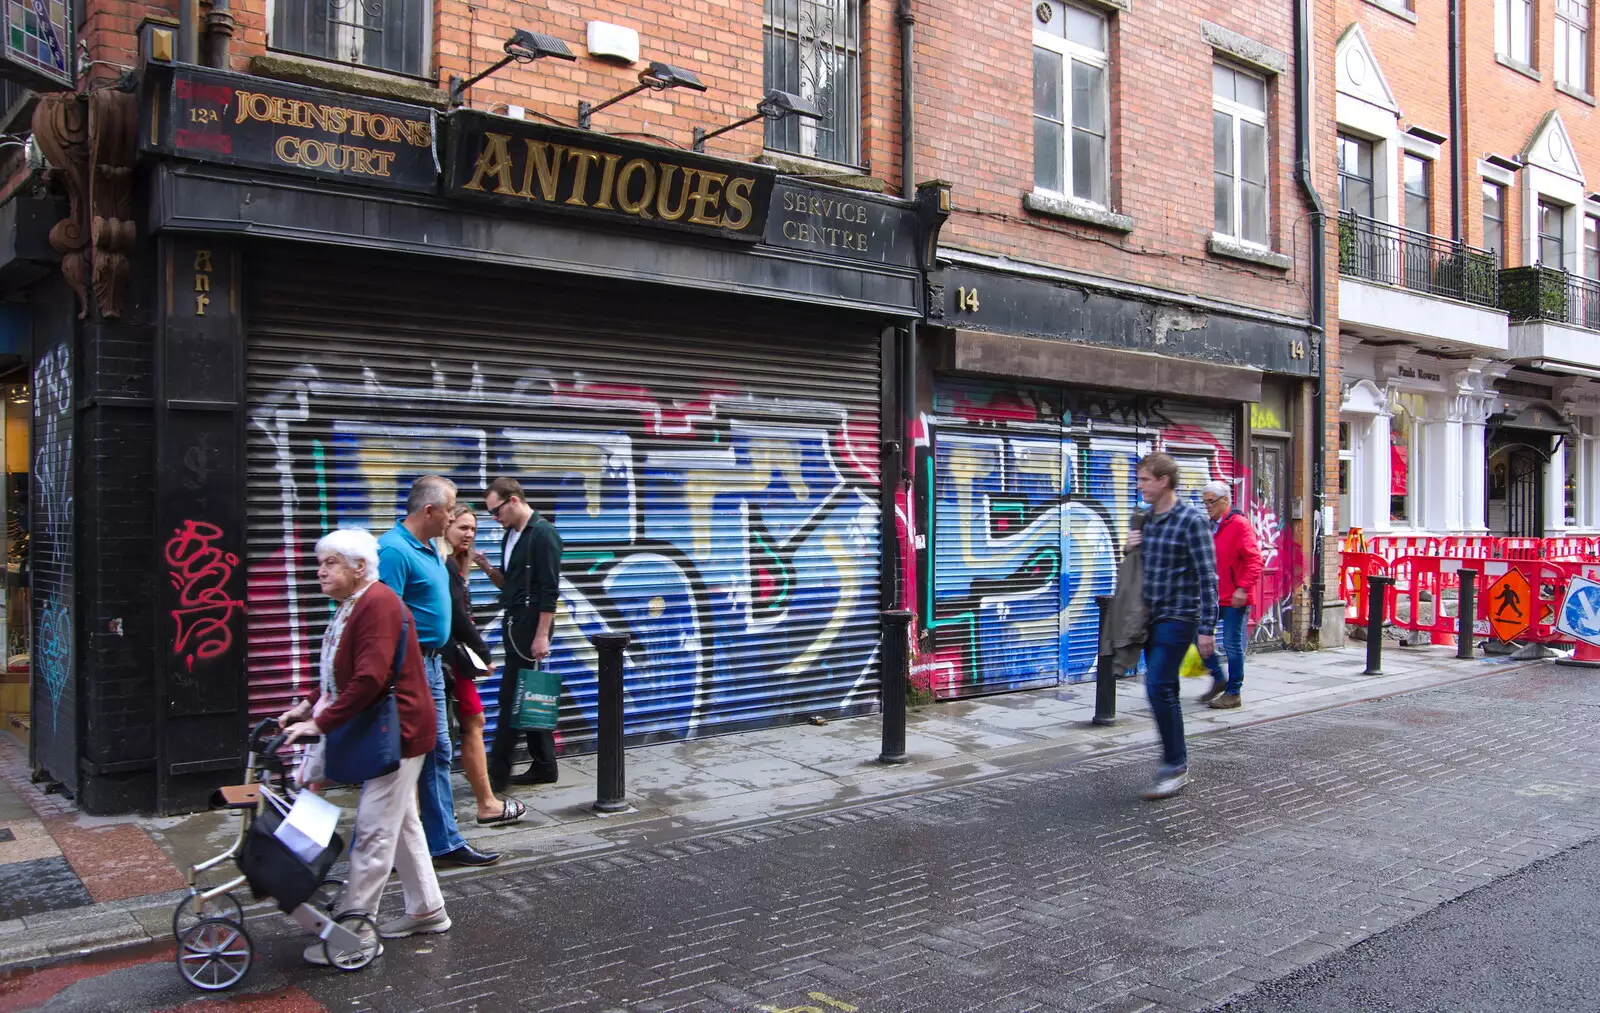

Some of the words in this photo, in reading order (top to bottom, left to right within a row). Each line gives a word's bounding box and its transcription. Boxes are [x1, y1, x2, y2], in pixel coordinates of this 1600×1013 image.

[235, 90, 431, 148] JOHNSTONS
[275, 135, 396, 177] COURT
[461, 131, 757, 230] ANTIQUES
[782, 191, 868, 225] SERVICE
[782, 219, 869, 251] CENTRE
[958, 286, 980, 312] 14
[1290, 339, 1304, 359] 14
